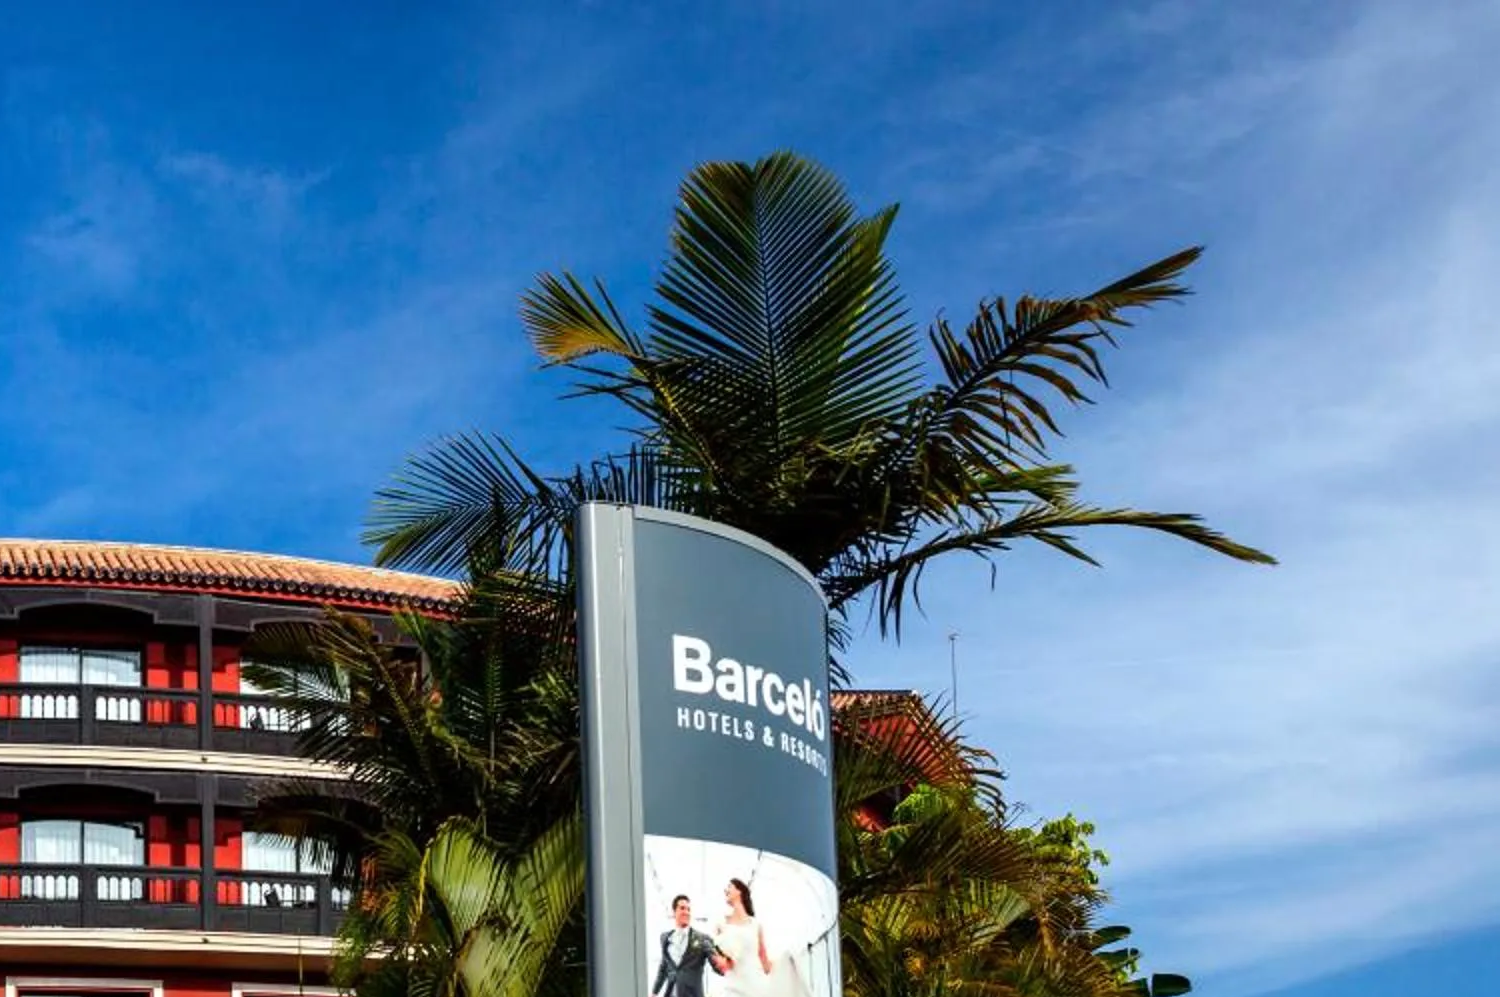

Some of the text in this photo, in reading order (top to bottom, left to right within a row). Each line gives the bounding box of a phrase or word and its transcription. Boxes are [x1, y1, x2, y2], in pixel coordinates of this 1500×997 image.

[672, 633, 825, 741] Barceló
[677, 707, 755, 741] HOTELS
[762, 725, 775, 748] &
